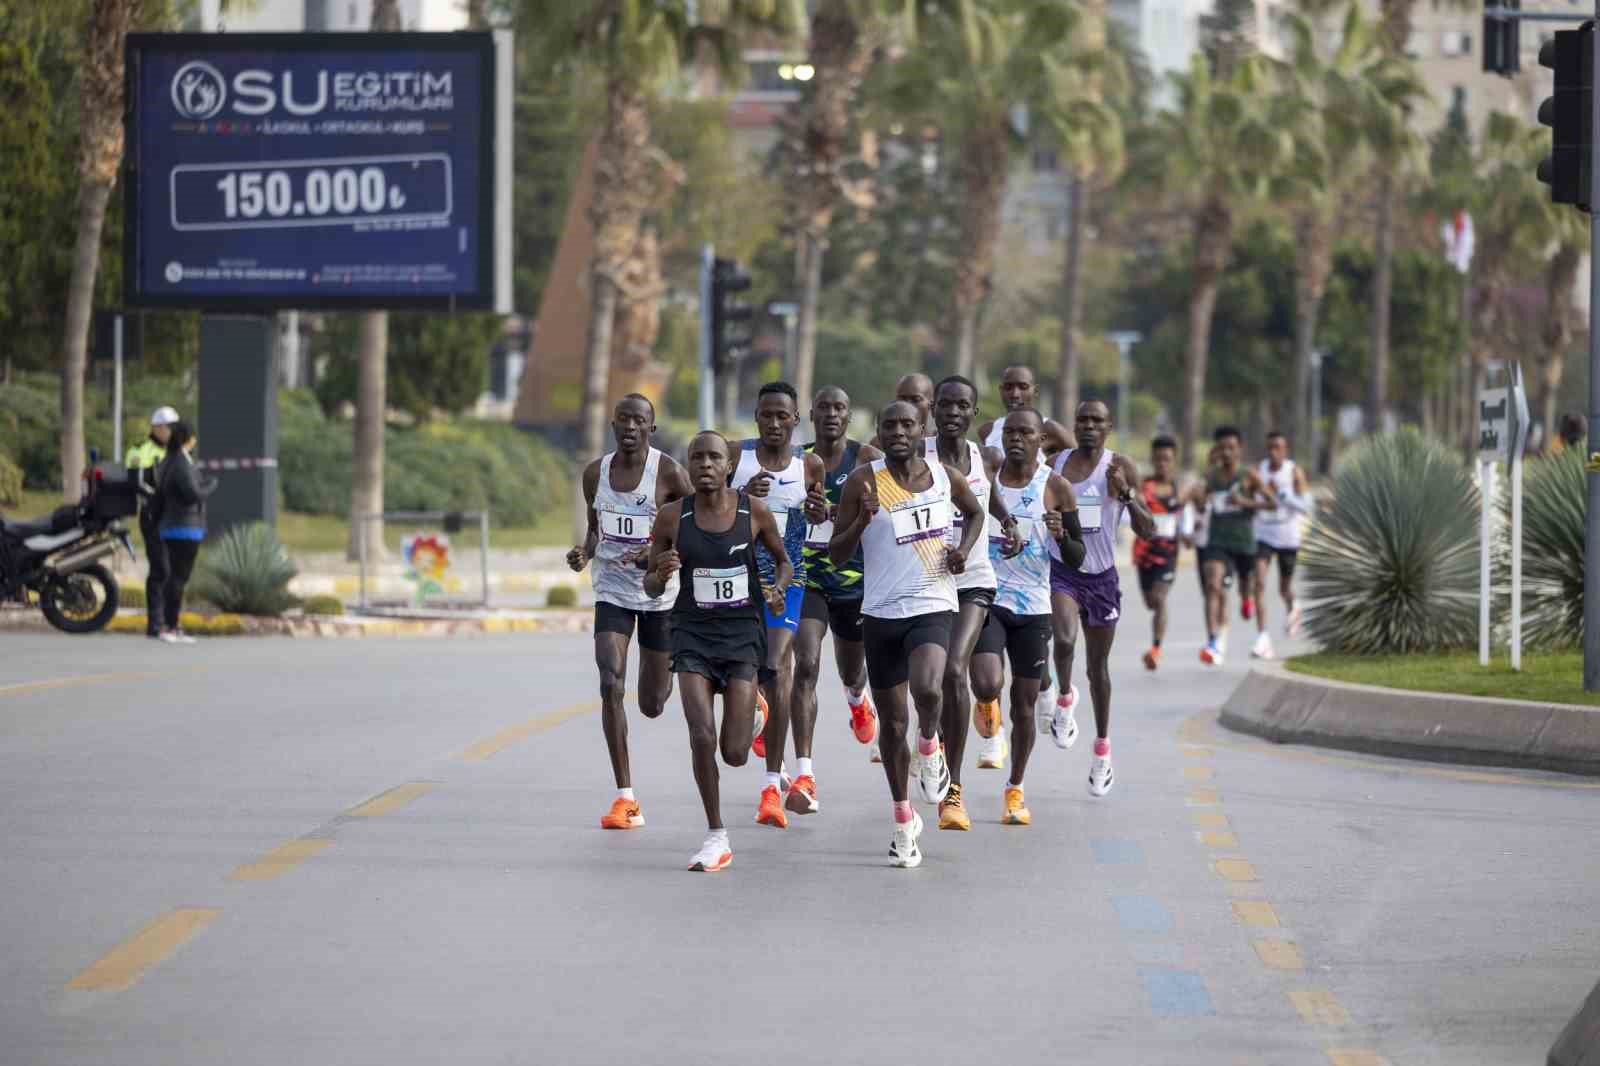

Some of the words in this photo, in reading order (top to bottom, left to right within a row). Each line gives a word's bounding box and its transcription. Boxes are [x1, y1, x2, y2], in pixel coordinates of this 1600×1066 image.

[233, 70, 329, 115] SU
[616, 516, 633, 535] 10
[912, 507, 930, 530] 17
[713, 580, 734, 600] 18
